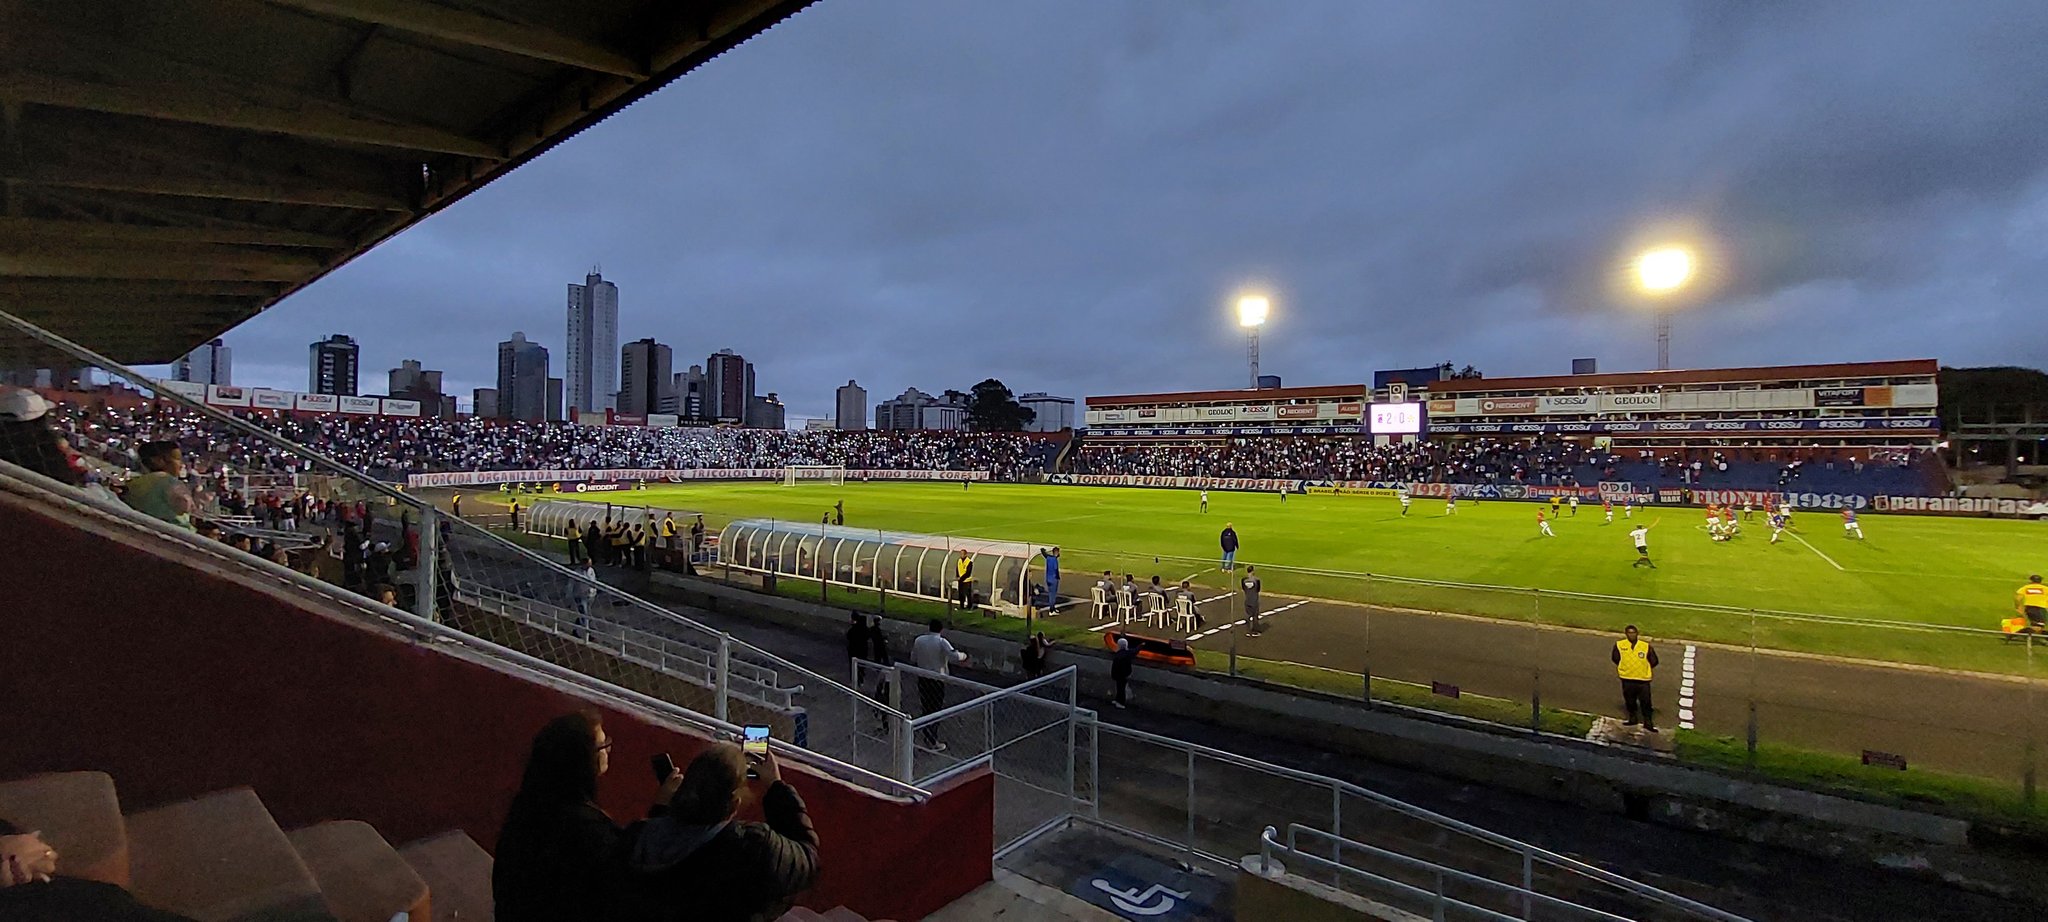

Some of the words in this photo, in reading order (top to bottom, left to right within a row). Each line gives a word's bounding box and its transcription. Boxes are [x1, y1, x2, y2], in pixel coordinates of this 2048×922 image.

[1614, 396, 1657, 405] GEOLOC
[425, 473, 472, 486] TORCIDA
[477, 471, 553, 483] ORGANIZADA
[692, 469, 748, 478] TRICOLOR
[906, 470, 933, 479] SUAS
[1077, 475, 1129, 485] TORCIDA
[1134, 476, 1178, 486] FURIA
[1787, 492, 1867, 509] 1989
[1890, 496, 2031, 515] paranautas
